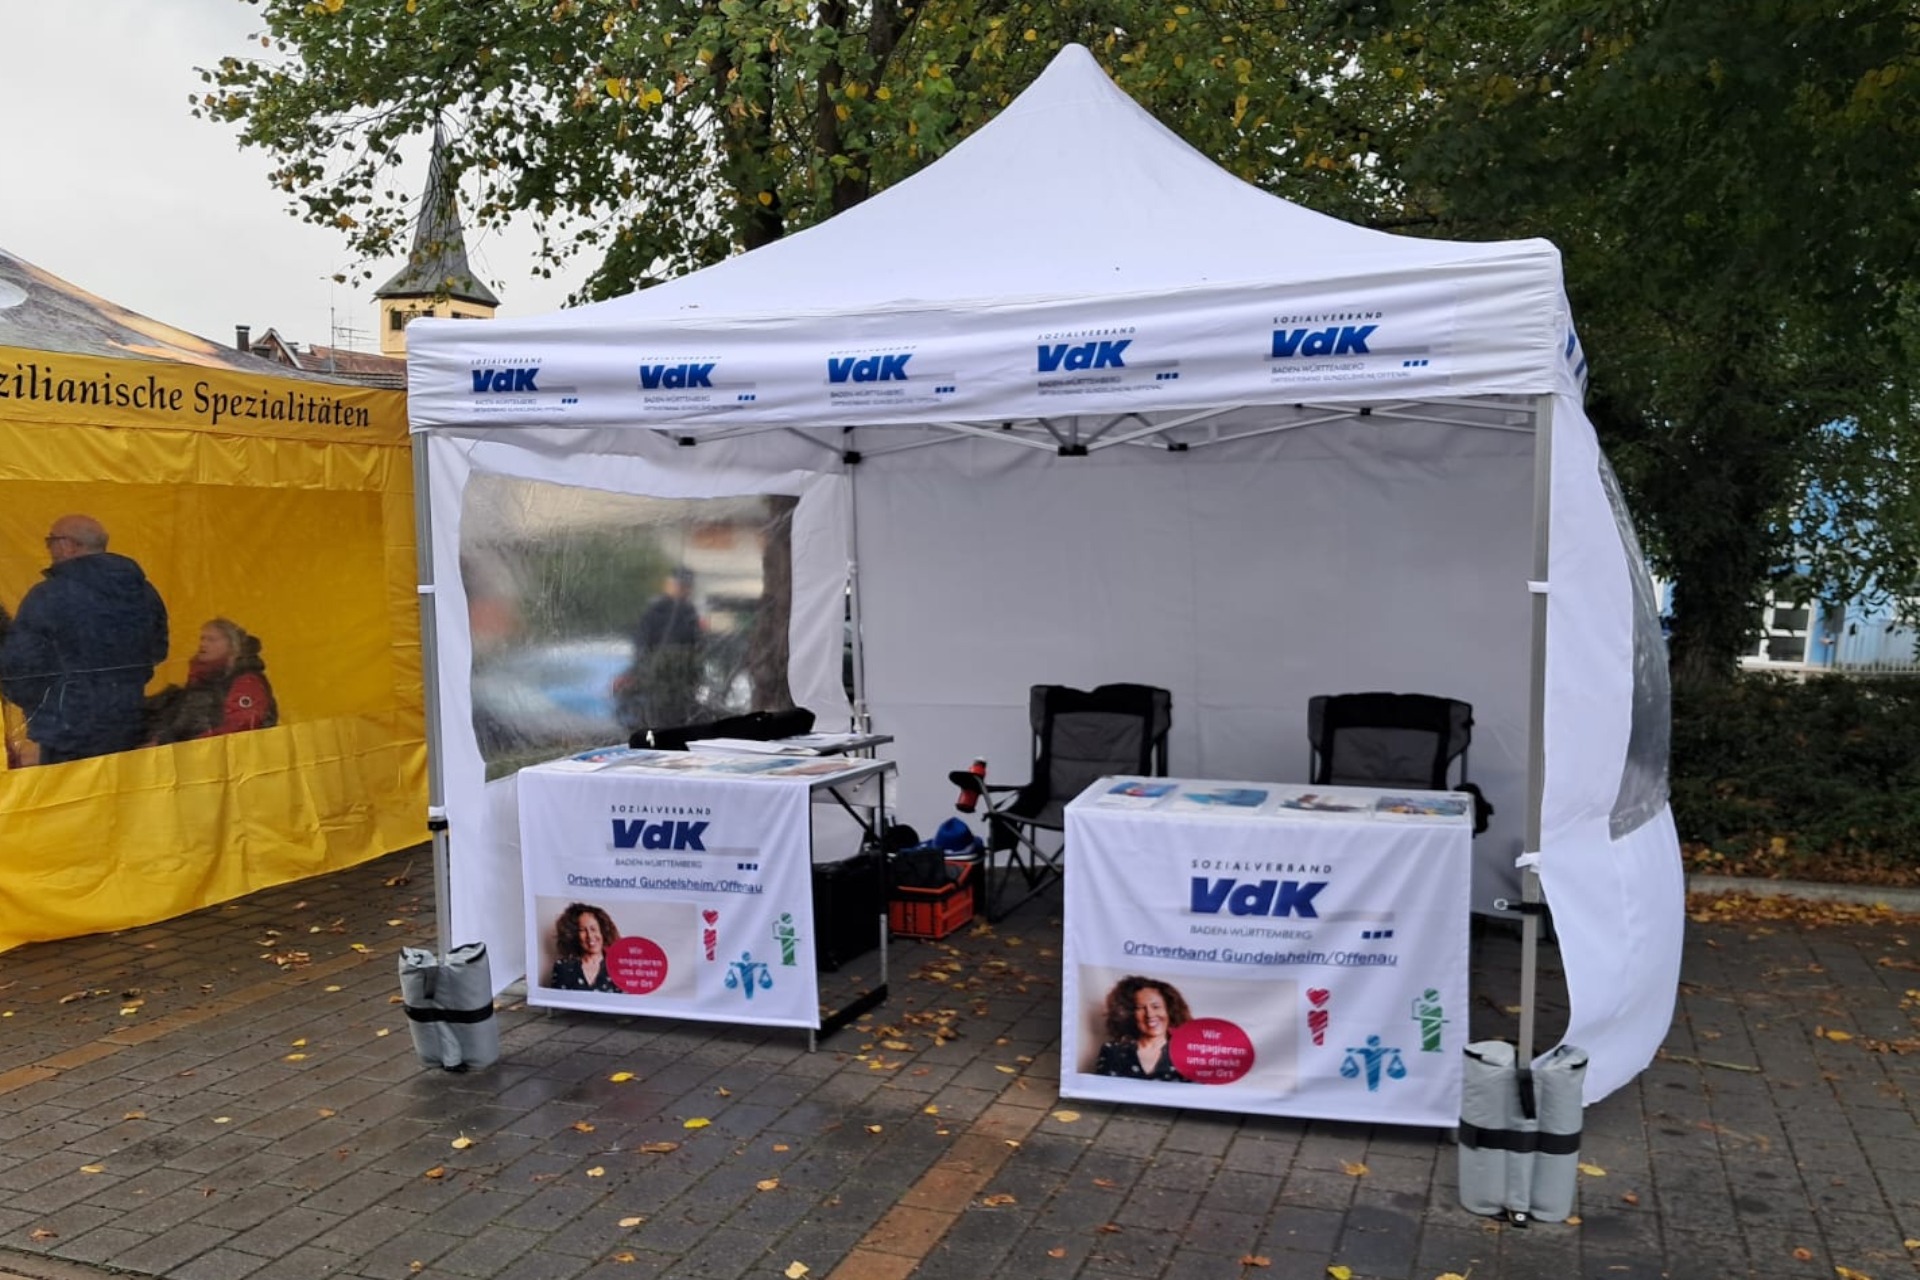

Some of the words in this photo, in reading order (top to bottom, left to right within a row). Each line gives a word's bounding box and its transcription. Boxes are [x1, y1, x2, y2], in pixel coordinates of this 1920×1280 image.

[1273, 311, 1383, 324] SOZIALVERBAND
[1038, 327, 1136, 340] SOZIALVERBAND
[1271, 325, 1379, 357] VdK
[1038, 340, 1132, 372] VdK
[640, 363, 716, 389] VdK
[828, 354, 912, 383] VdK
[472, 368, 539, 392] VdK
[194, 381, 370, 427] Spezialitäten
[611, 805, 712, 816] SOZIALVERBAND
[612, 819, 710, 851] VdK
[1191, 859, 1333, 874] SOZIALVERBAND
[567, 874, 636, 889] Ortsverband
[1190, 877, 1329, 918] VdK
[1190, 925, 1313, 941] BADEN-WÜRTTEMBERG
[1124, 940, 1218, 960] Ortsverband
[1221, 948, 1398, 967] Gundelsheim/Offenau
[1202, 1028, 1221, 1040] Wir
[1186, 1043, 1247, 1056] engagieren
[1186, 1056, 1207, 1066] uns
